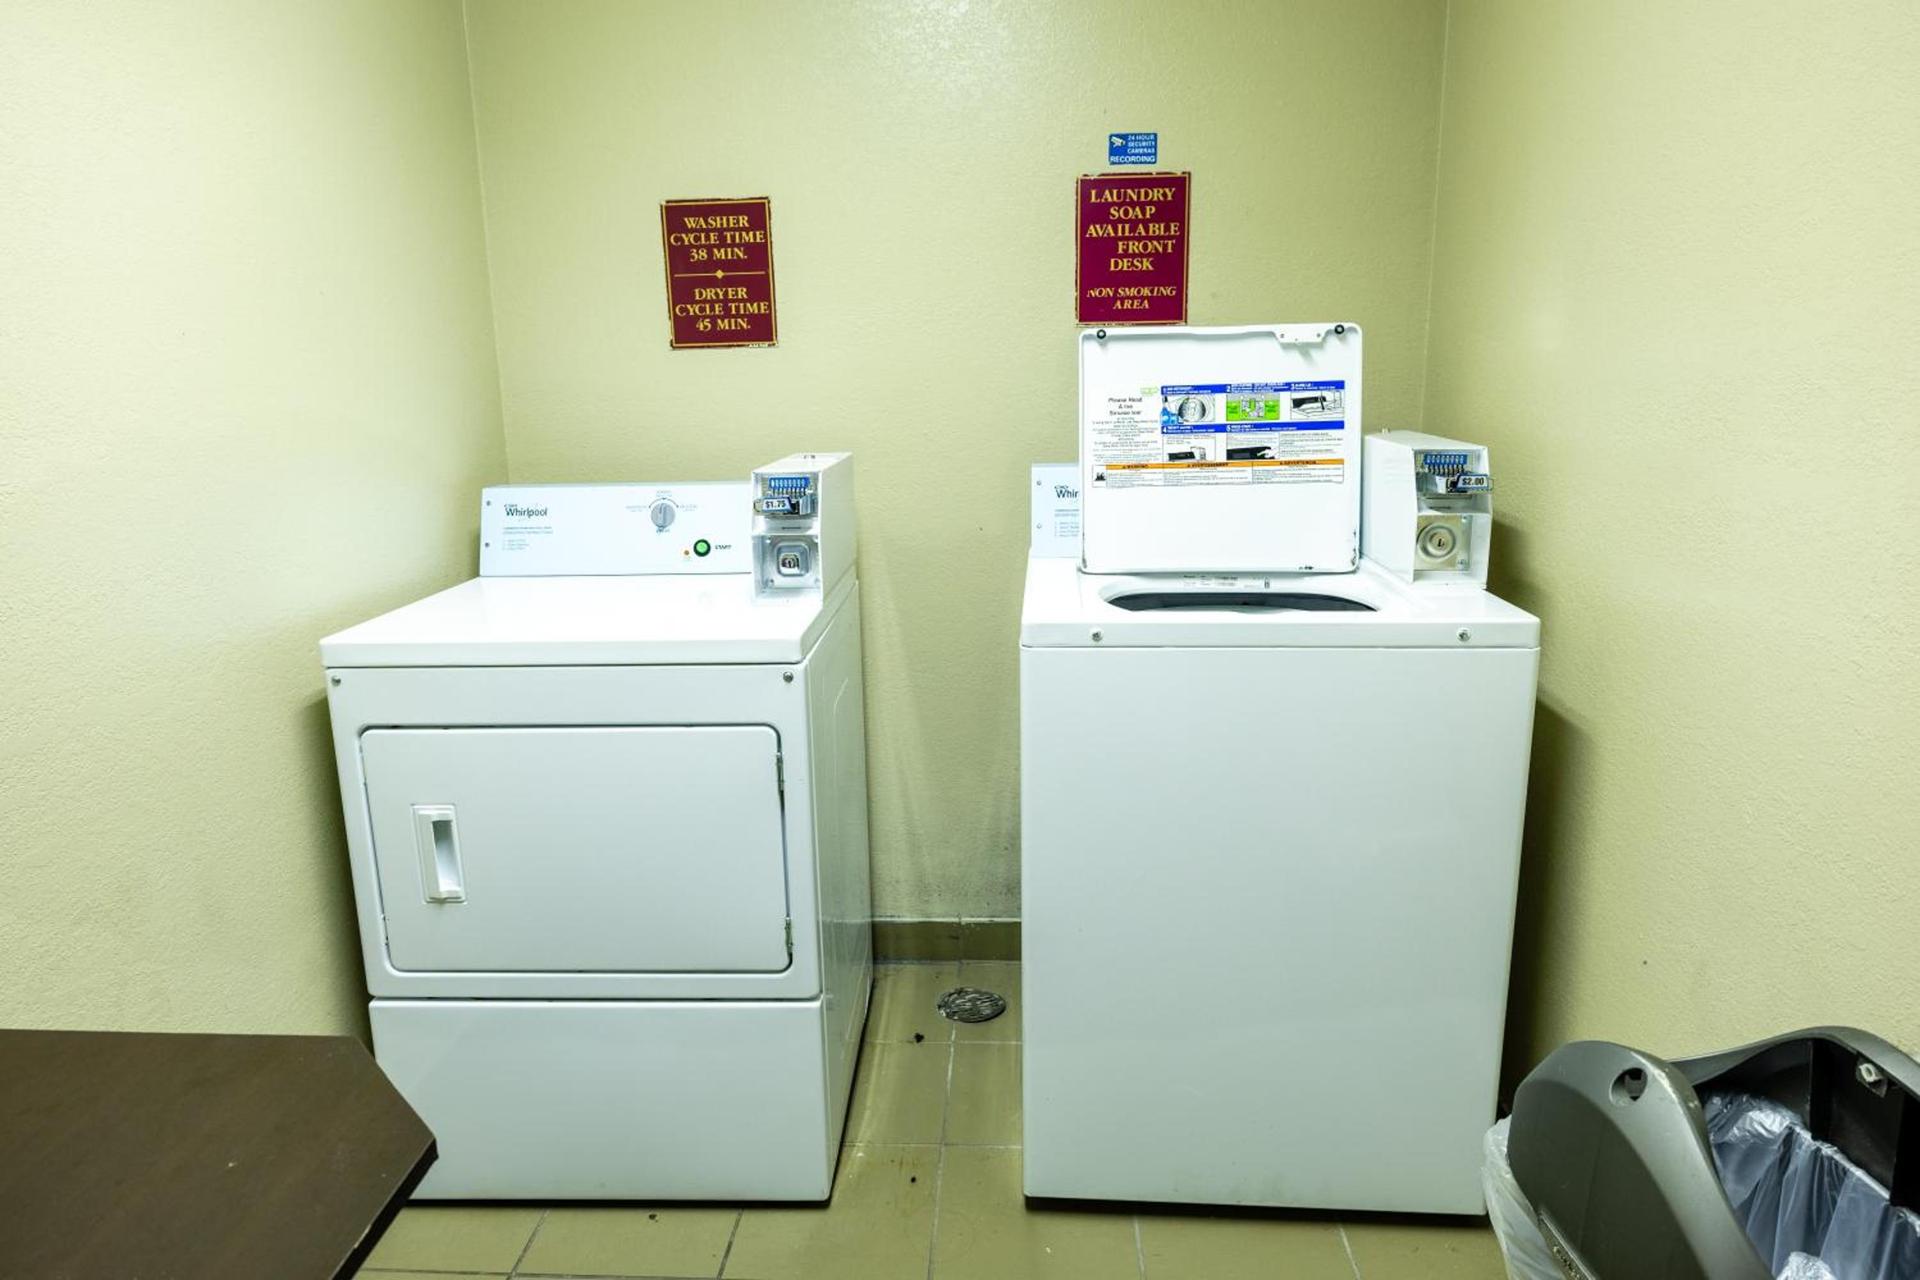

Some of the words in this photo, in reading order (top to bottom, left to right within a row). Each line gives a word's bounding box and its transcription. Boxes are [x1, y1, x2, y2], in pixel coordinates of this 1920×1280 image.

[1110, 155, 1156, 163] RECORDING
[1089, 187, 1176, 203] LAUNDRY
[1109, 206, 1156, 220] SOAP
[684, 215, 750, 229] WASHER
[1086, 222, 1180, 238] AVAILABLE
[670, 232, 720, 246] CYCLE
[724, 231, 765, 244] TIME
[1117, 240, 1176, 254] FRONT
[689, 248, 708, 262] 38
[712, 247, 748, 261] MIN.
[1109, 257, 1155, 272] DESK
[694, 286, 748, 300] DRYER
[1086, 287, 1115, 298] NON
[1117, 285, 1177, 298] SMOKING
[675, 303, 724, 317] CYCLE
[728, 301, 769, 315] TIME
[1113, 299, 1150, 310] AREA
[696, 318, 711, 332] 45
[716, 318, 751, 331] MIN.
[1461, 477, 1485, 486] $2.00
[764, 499, 787, 509] $1.75
[504, 506, 548, 519] Whirlpool
